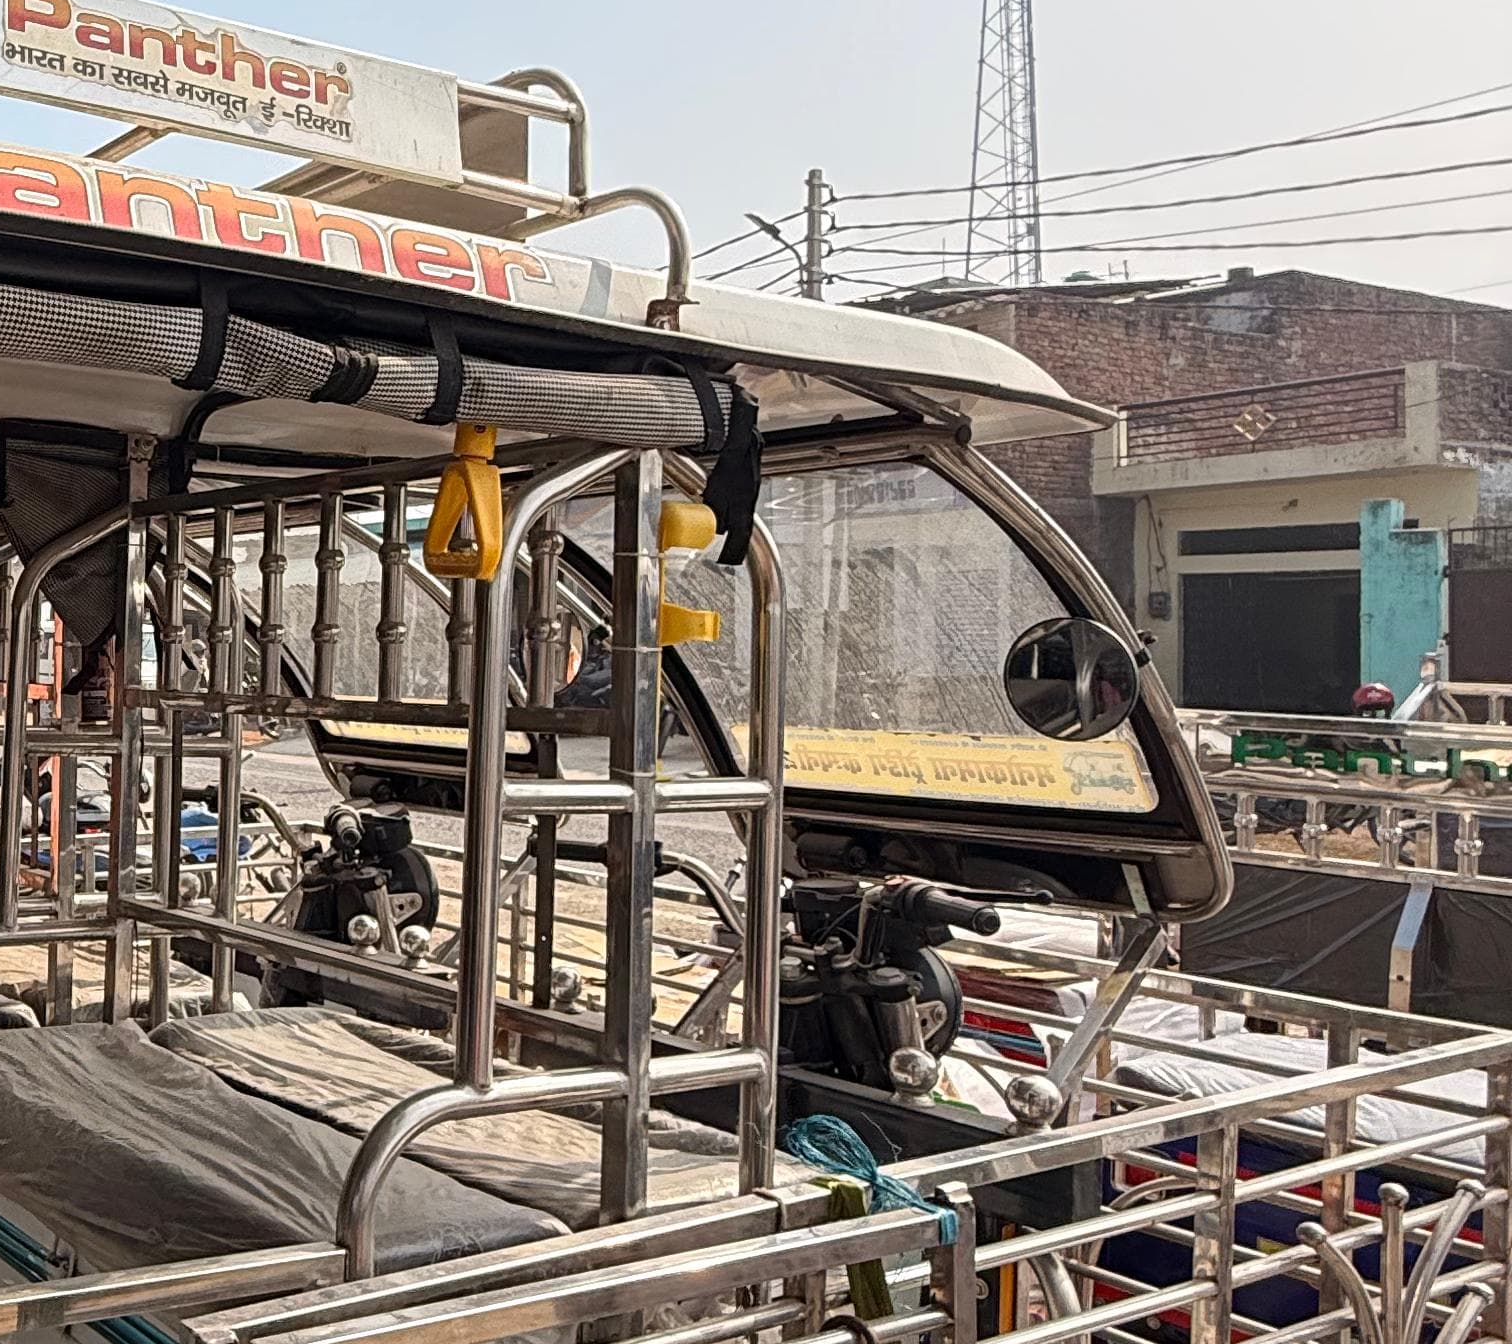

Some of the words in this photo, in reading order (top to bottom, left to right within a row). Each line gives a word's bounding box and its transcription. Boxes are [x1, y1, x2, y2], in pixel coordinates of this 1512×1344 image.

[4, 41, 67, 74] भारत
[71, 55, 106, 82] का
[111, 64, 170, 96] सबसे
[1231, 729, 1512, 783] Panth
